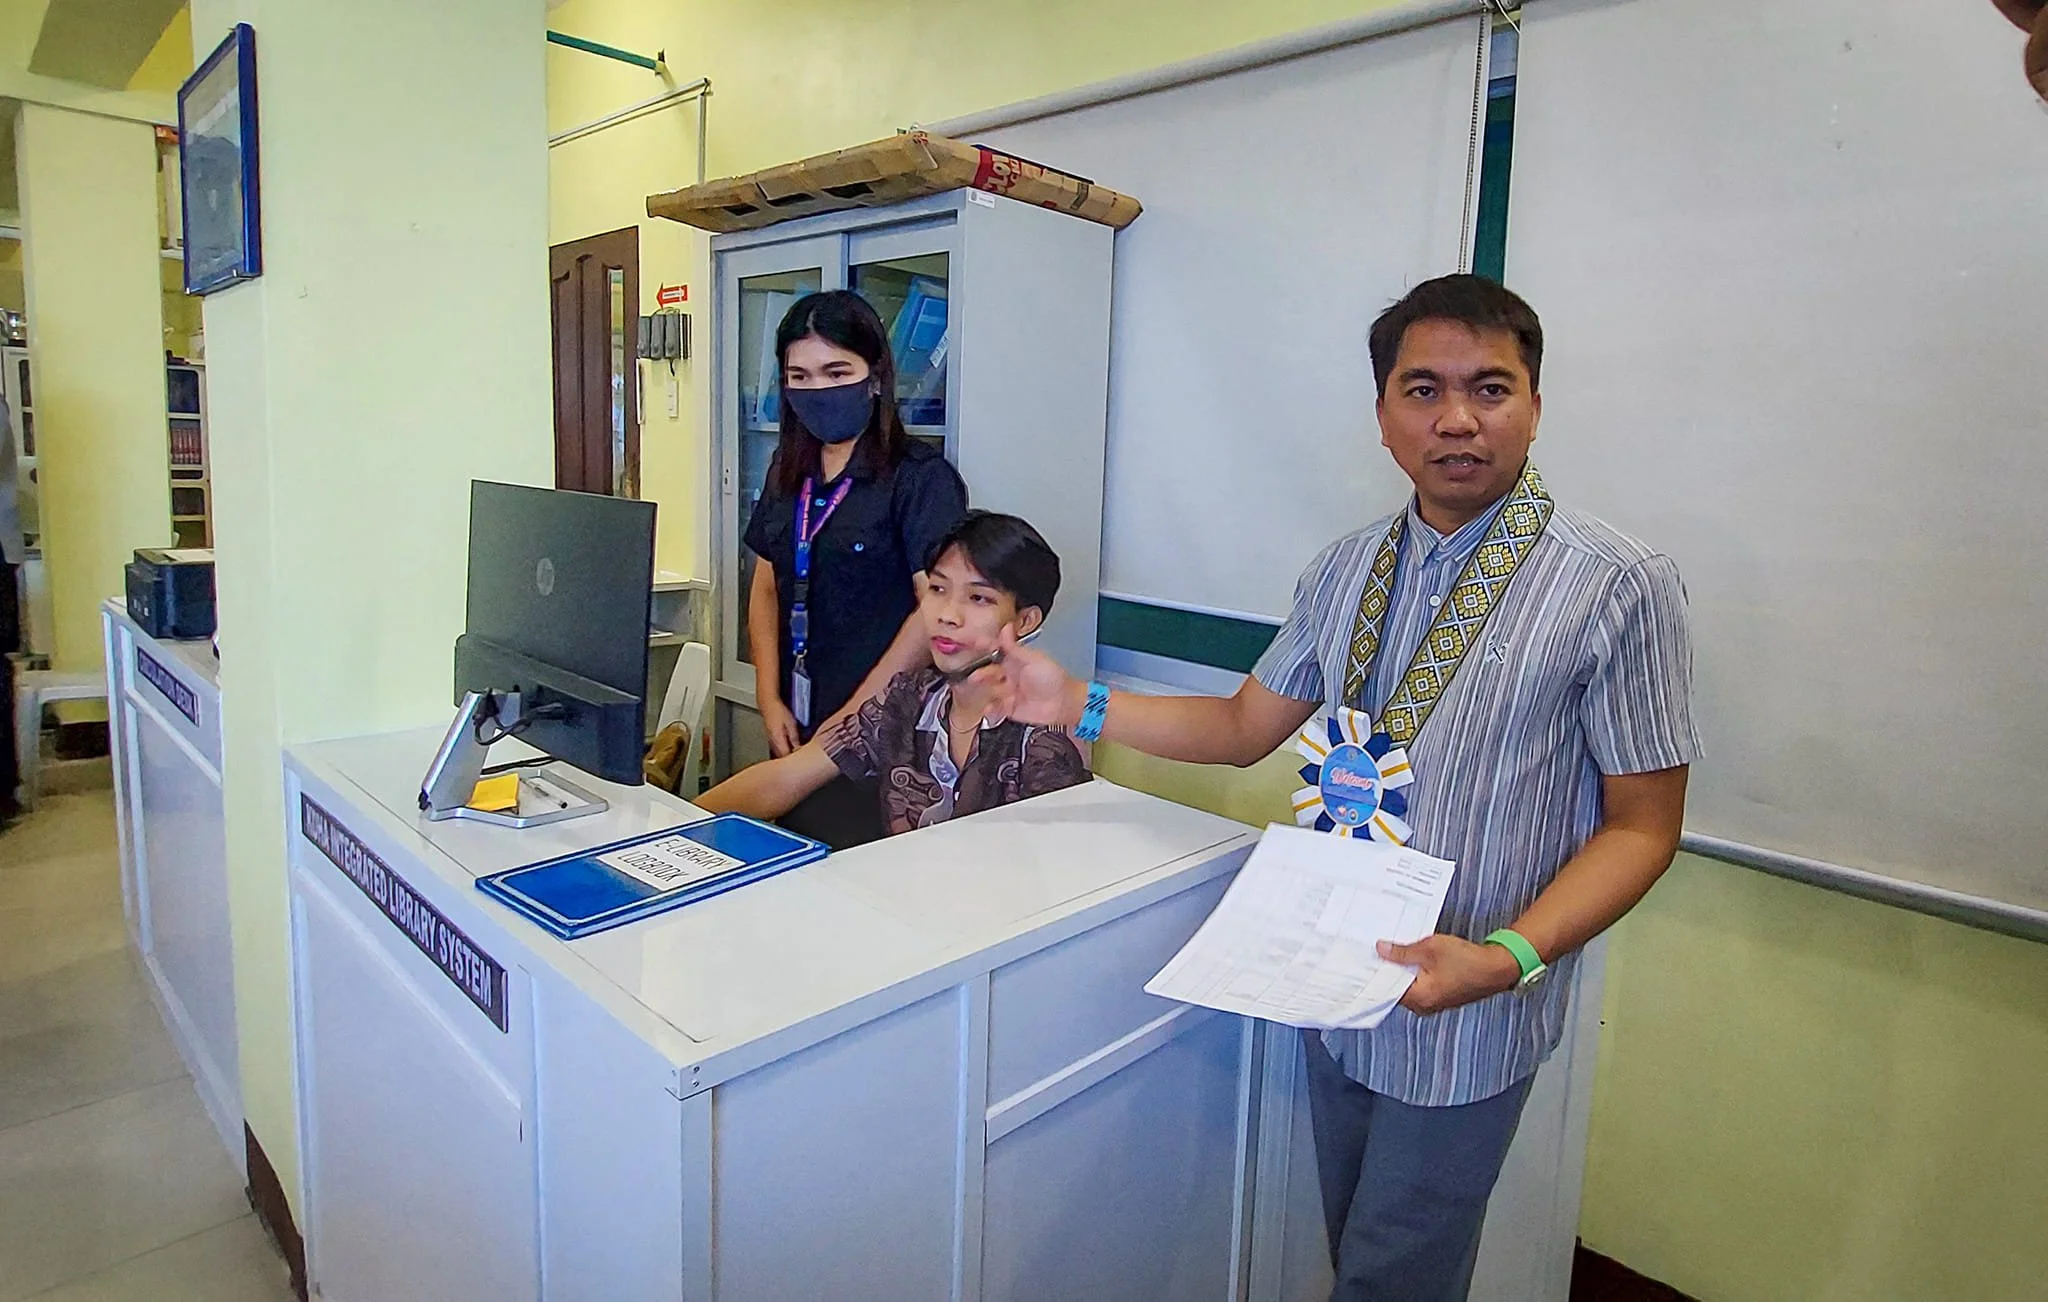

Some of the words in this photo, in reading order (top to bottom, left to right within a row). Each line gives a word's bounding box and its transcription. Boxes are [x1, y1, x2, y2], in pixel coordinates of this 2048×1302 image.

[617, 850, 690, 882] LOGBOOK
[655, 838, 734, 870] E-LIBRARY
[330, 823, 387, 906] INTEGRATED
[389, 876, 436, 953] LIBRARY
[439, 923, 492, 1009] SYSTEM
